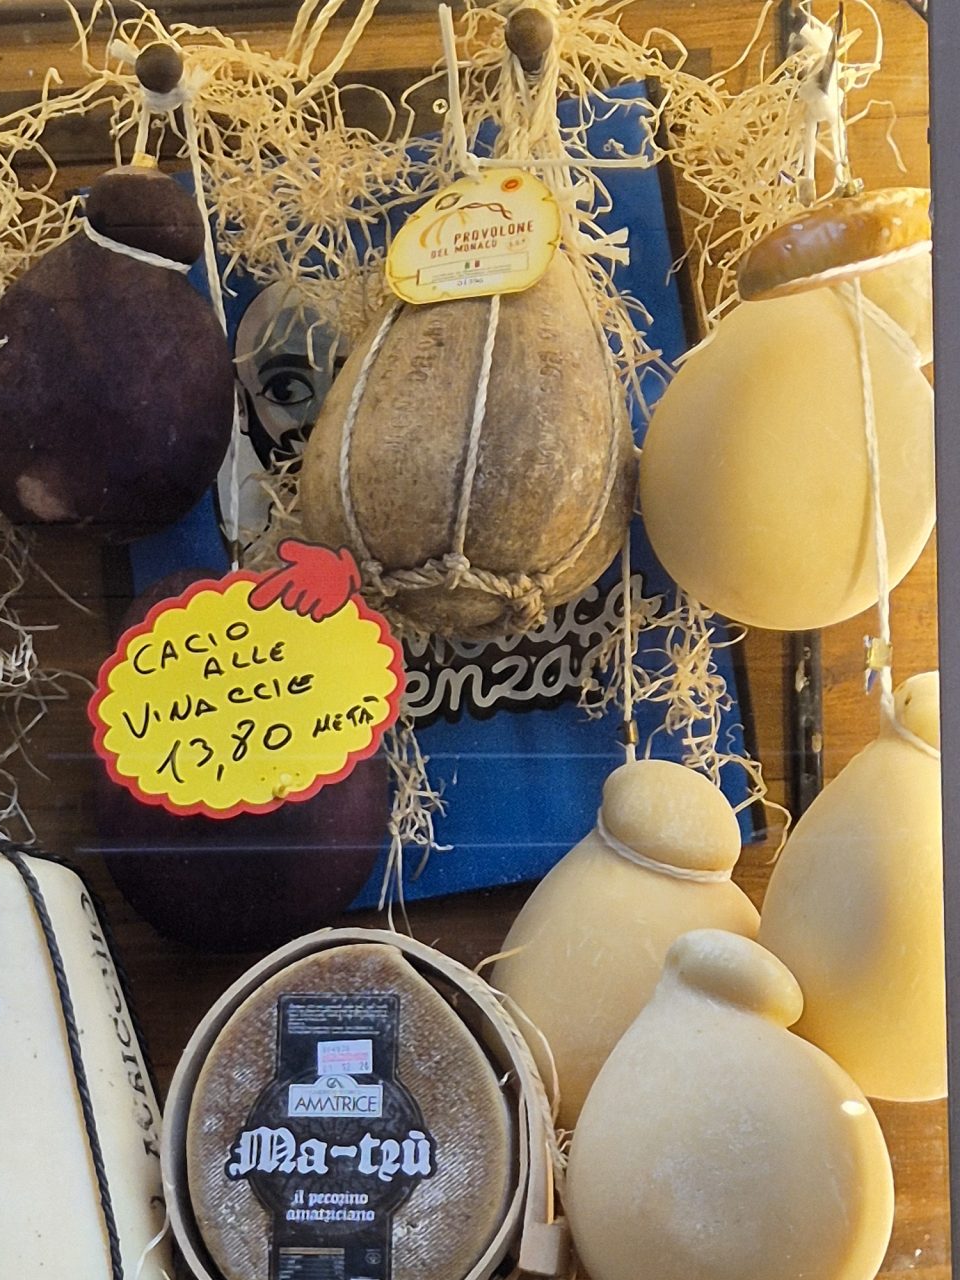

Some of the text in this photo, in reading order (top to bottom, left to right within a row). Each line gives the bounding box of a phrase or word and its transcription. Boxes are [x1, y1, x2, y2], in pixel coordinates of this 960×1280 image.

[453, 220, 534, 245] PROVOLONE
[430, 249, 449, 260] DEL
[454, 240, 498, 255] MONACO
[133, 621, 250, 675] CACIO
[203, 641, 286, 679] ALLE
[294, 1095, 378, 1112] AMATRICE
